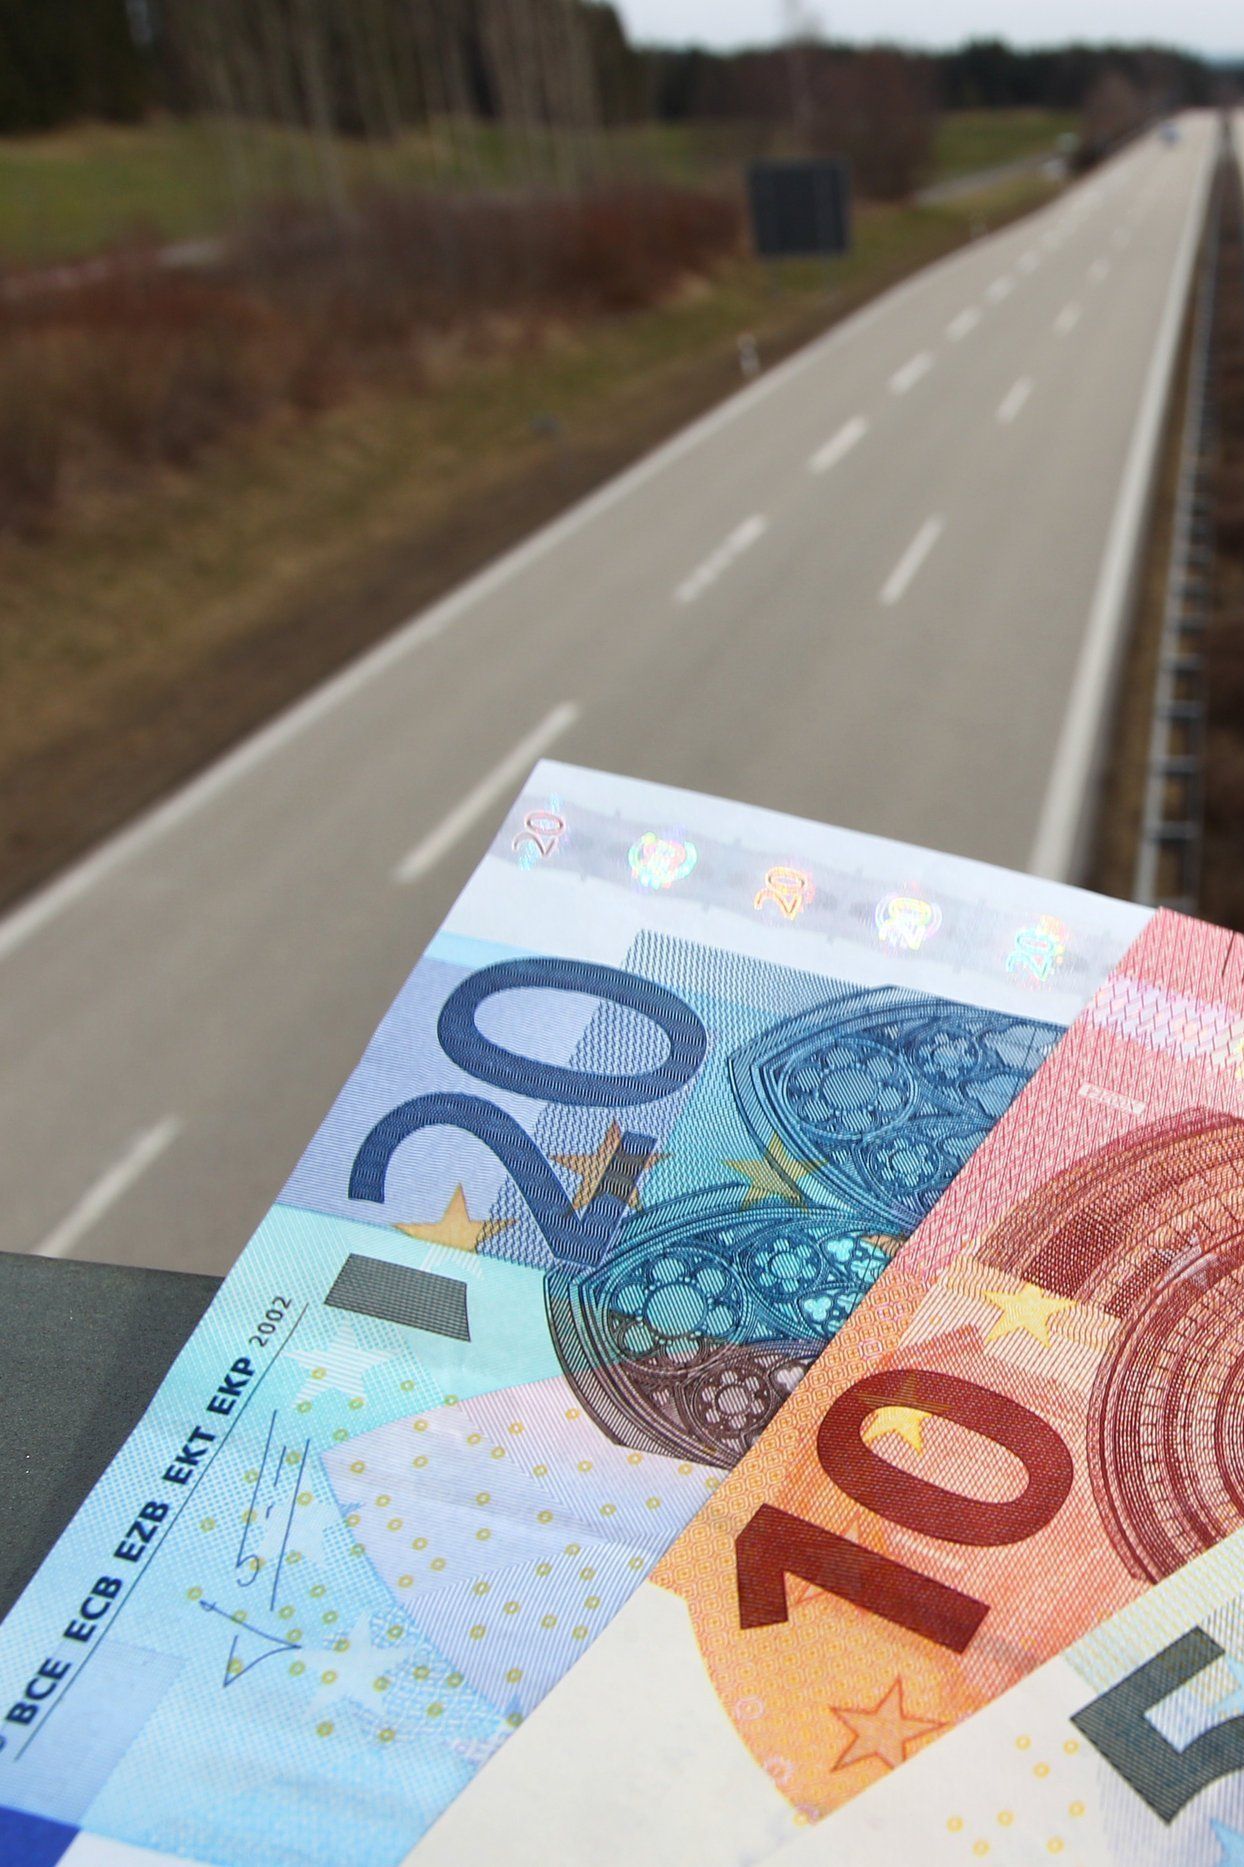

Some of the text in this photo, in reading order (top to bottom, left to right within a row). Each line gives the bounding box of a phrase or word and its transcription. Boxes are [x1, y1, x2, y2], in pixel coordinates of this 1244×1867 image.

[511, 808, 567, 859] 20
[754, 865, 809, 921] 20
[1004, 926, 1062, 982] 20
[347, 955, 708, 1267] 20
[5, 1657, 72, 1726] BCE
[63, 1574, 124, 1644] ECB
[113, 1499, 170, 1563] EZB
[161, 1426, 217, 1486] EKT
[206, 1356, 256, 1416] EKP
[248, 1295, 293, 1346] 2002
[734, 1368, 1074, 1654] 10
